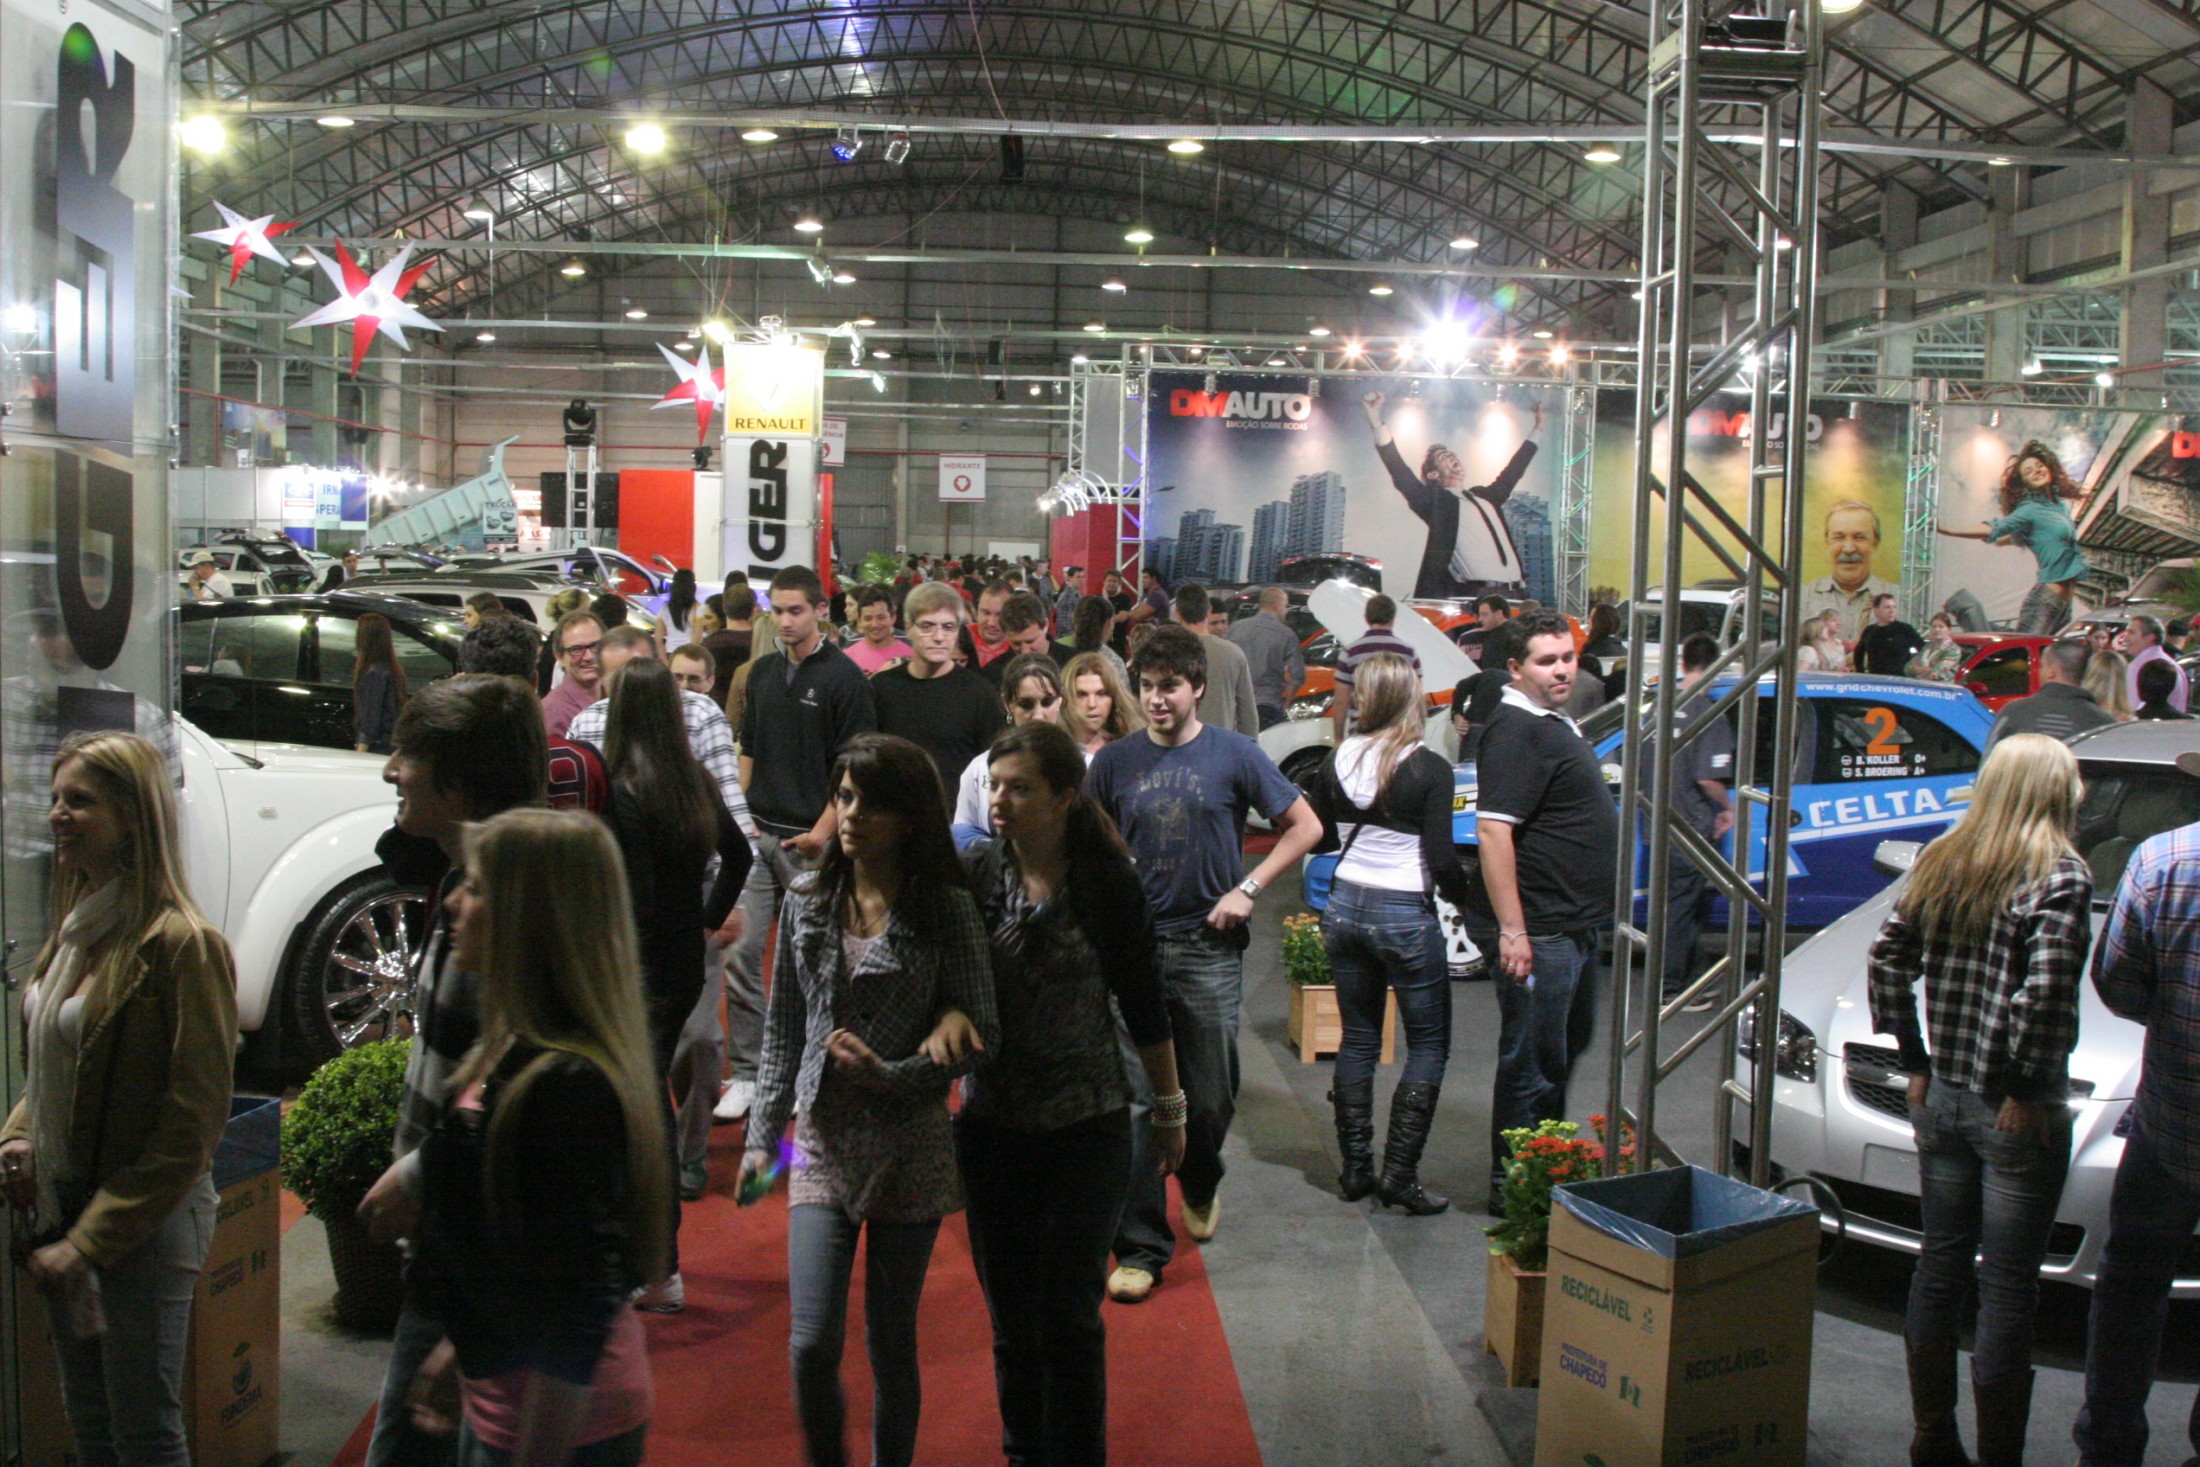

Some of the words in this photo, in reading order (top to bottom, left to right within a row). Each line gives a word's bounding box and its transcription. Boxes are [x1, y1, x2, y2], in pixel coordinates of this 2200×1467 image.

[735, 418, 806, 430] RENAULT
[1225, 420, 1259, 430] EMOÇÃO
[1260, 421, 1283, 429] SOBRE
[1283, 422, 1309, 430] RODAS
[1687, 409, 1824, 441] DMAUO
[943, 462, 982, 470] HIDRANTE
[1805, 682, 1957, 700] www.gridchevrolet.com.br
[1864, 706, 1901, 756] 2
[1855, 754, 1866, 765] B.
[1866, 753, 1900, 765] KOLLER
[1855, 767, 1865, 777] S.
[1865, 766, 1908, 777] BROERING
[1808, 788, 1943, 828] CELTA
[1561, 1274, 1632, 1322] RECICLÁVEL
[1560, 1354, 1607, 1389] CHAPECÓ
